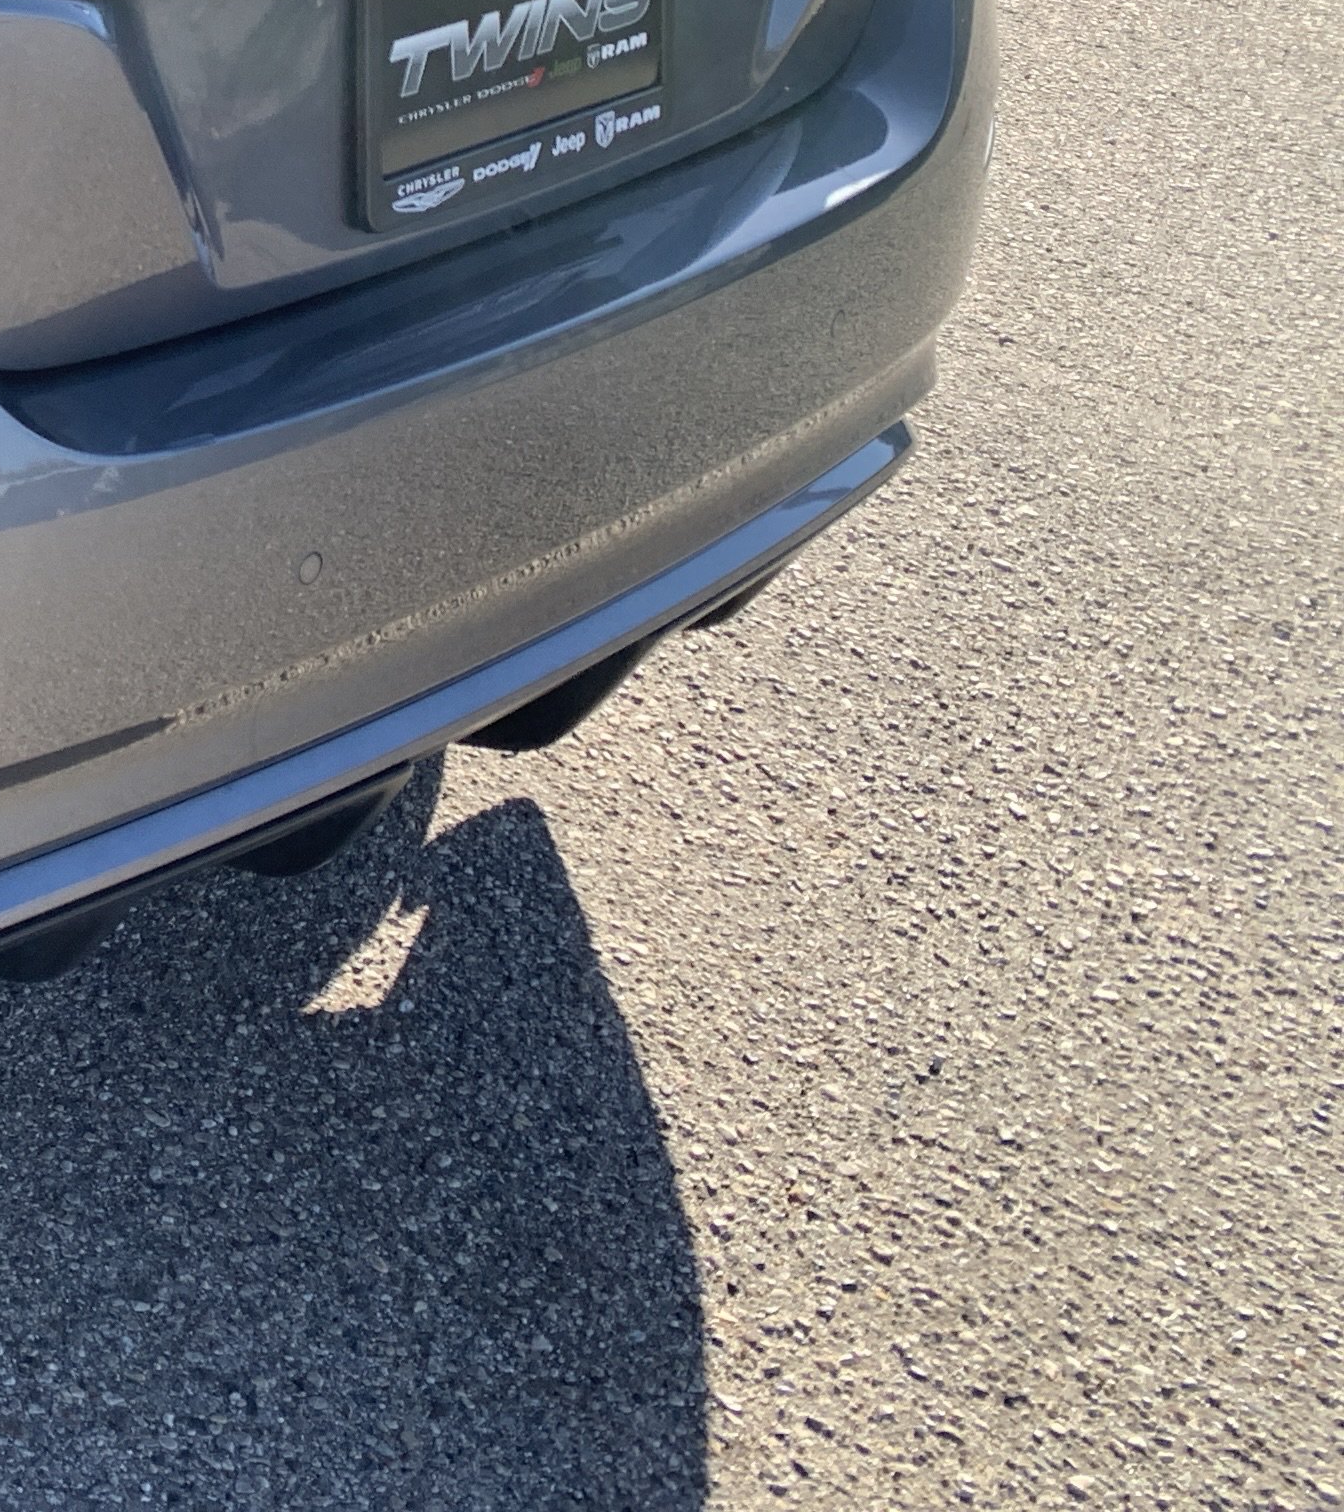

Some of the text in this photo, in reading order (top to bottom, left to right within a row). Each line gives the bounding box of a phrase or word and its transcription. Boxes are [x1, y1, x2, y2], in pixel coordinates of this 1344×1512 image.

[397, 93, 472, 125] CHRYSLER
[476, 72, 537, 100] DODGE
[601, 32, 648, 60] RAM
[397, 105, 661, 197] CHRYSLER DODGE Jeep RAM
